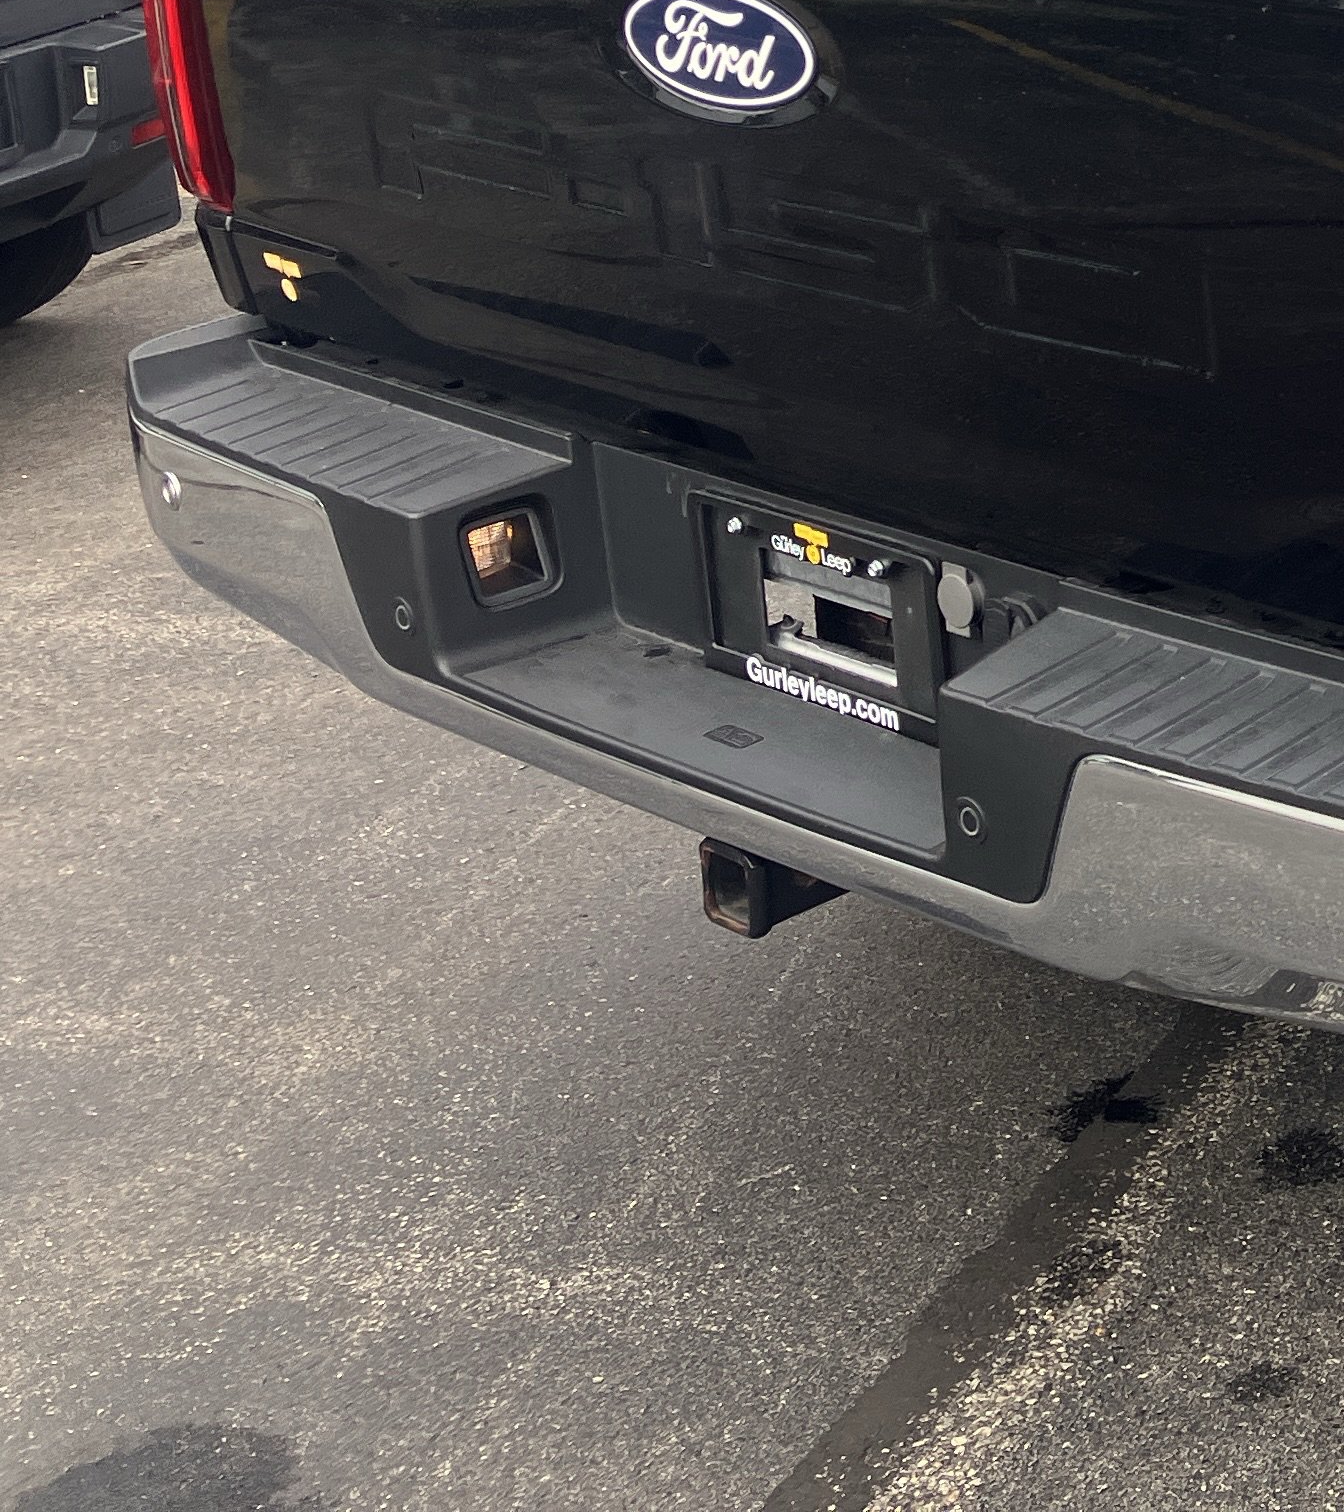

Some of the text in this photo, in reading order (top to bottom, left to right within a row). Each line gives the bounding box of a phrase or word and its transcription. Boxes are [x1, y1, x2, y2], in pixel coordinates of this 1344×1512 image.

[655, 0, 776, 90] Ford
[820, 547, 853, 576] Leep
[745, 655, 900, 732] Gurleyleep.com
